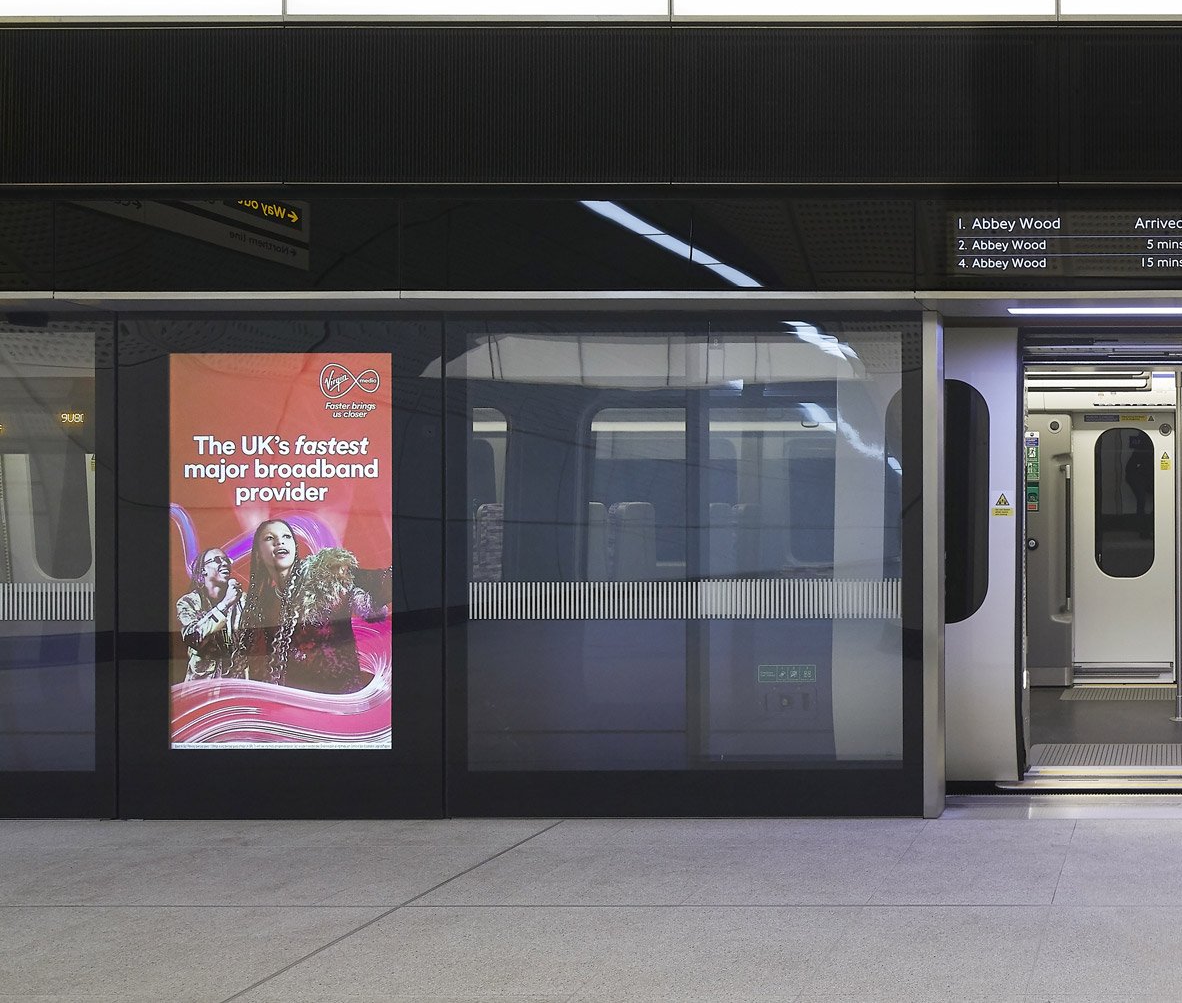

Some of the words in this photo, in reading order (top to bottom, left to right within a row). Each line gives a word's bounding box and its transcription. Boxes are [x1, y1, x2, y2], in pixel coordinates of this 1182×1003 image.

[972, 217, 1016, 232] Abbey
[1019, 217, 1061, 230] Wood
[958, 239, 968, 250] 2.
[972, 239, 1009, 252] Abbey
[1011, 239, 1047, 250] Wood
[1146, 239, 1154, 250] 5
[958, 258, 969, 268] 4.
[972, 257, 1009, 271] Abbey
[1011, 257, 1047, 268] Wood
[1141, 257, 1154, 268] 15
[325, 370, 349, 392] Virgin
[325, 402, 351, 410] Faster
[352, 402, 376, 411] brings
[343, 410, 368, 418] closer
[193, 436, 236, 455] The
[241, 436, 290, 455] UK's
[294, 435, 369, 455] fastest
[184, 459, 249, 482] major
[254, 459, 379, 478] broadband
[235, 482, 329, 505] provider
